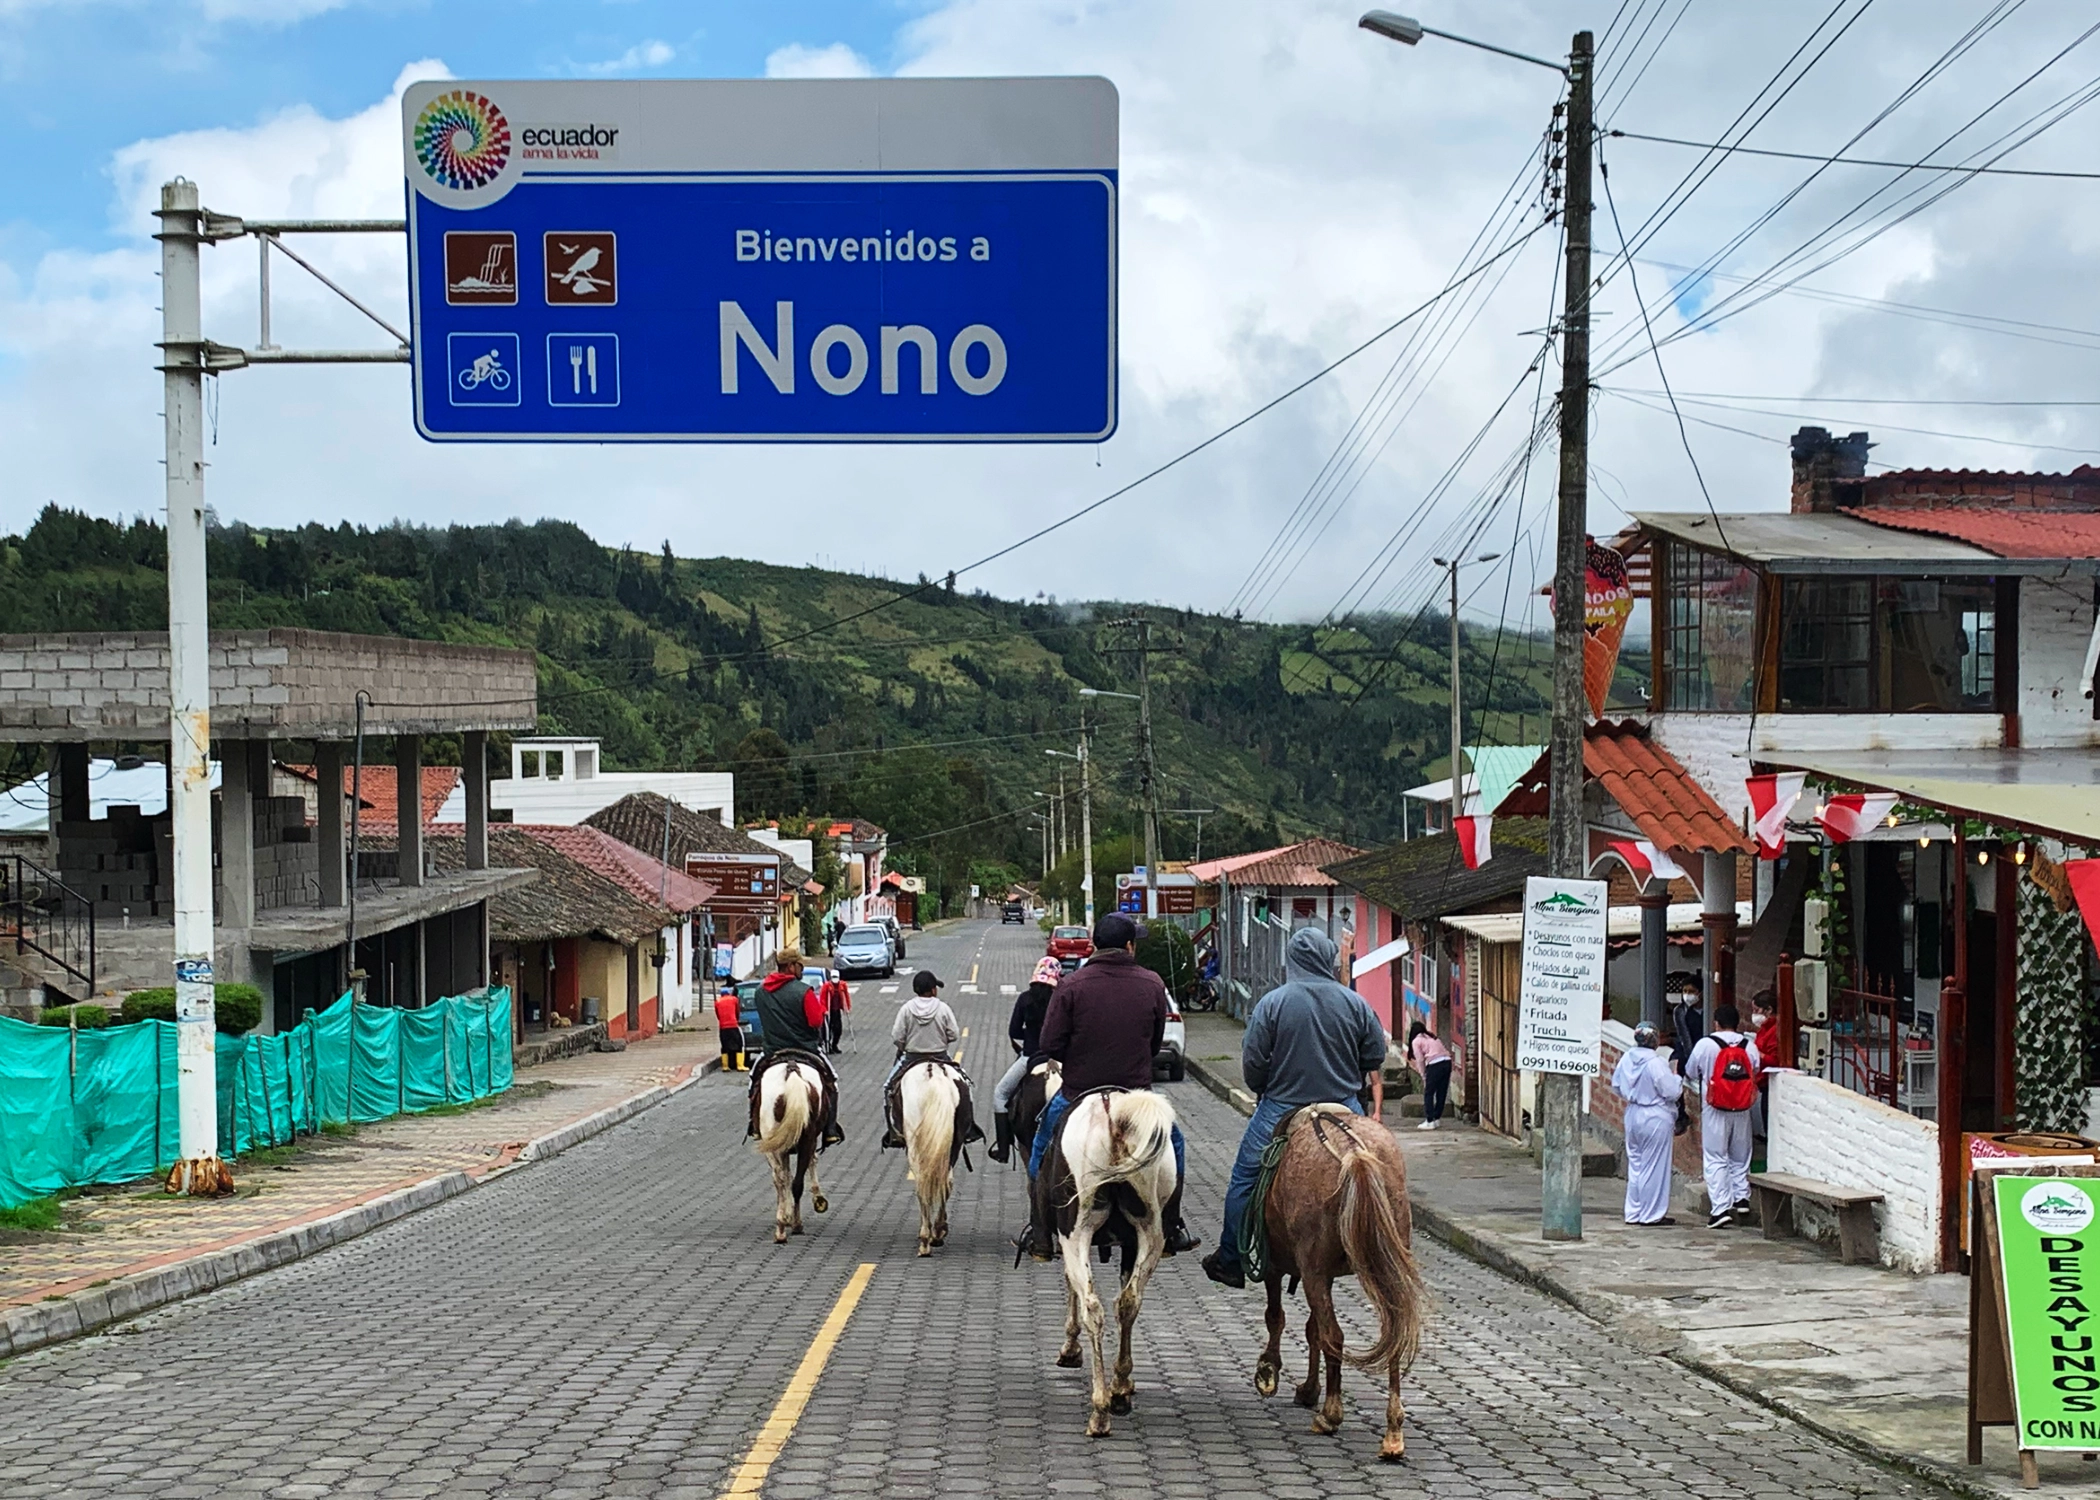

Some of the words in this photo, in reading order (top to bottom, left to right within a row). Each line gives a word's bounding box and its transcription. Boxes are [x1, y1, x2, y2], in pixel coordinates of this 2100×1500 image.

[522, 123, 619, 146] ecuador
[522, 148, 553, 159] ama
[557, 147, 568, 159] la
[571, 147, 599, 159] vida
[735, 229, 957, 263] Bienvenidos
[970, 239, 991, 263] a
[719, 300, 1008, 397] Nono
[1534, 930, 1571, 943] Desayunos
[1573, 936, 1586, 945] con
[1588, 936, 1603, 945] nata
[1533, 945, 1559, 958] Choclos
[1561, 950, 1573, 959] con
[1575, 952, 1595, 961] queso
[1532, 961, 1560, 974] Helados
[1562, 964, 1571, 974] de
[1531, 976, 1549, 988] Caldo
[1551, 979, 1558, 989] de
[1560, 981, 1580, 991] gallina
[1530, 1008, 1567, 1021] Fritada
[1530, 1023, 1567, 1036] Trucha
[1529, 1039, 1550, 1052] Higos
[1552, 1043, 1566, 1052] con
[1568, 1045, 1589, 1055] queso
[1522, 1056, 1598, 1074] 0991169608
[2040, 1236, 2100, 1412] DESAYUNOS
[2027, 1420, 2074, 1439] CON
[2080, 1421, 2100, 1439] N
